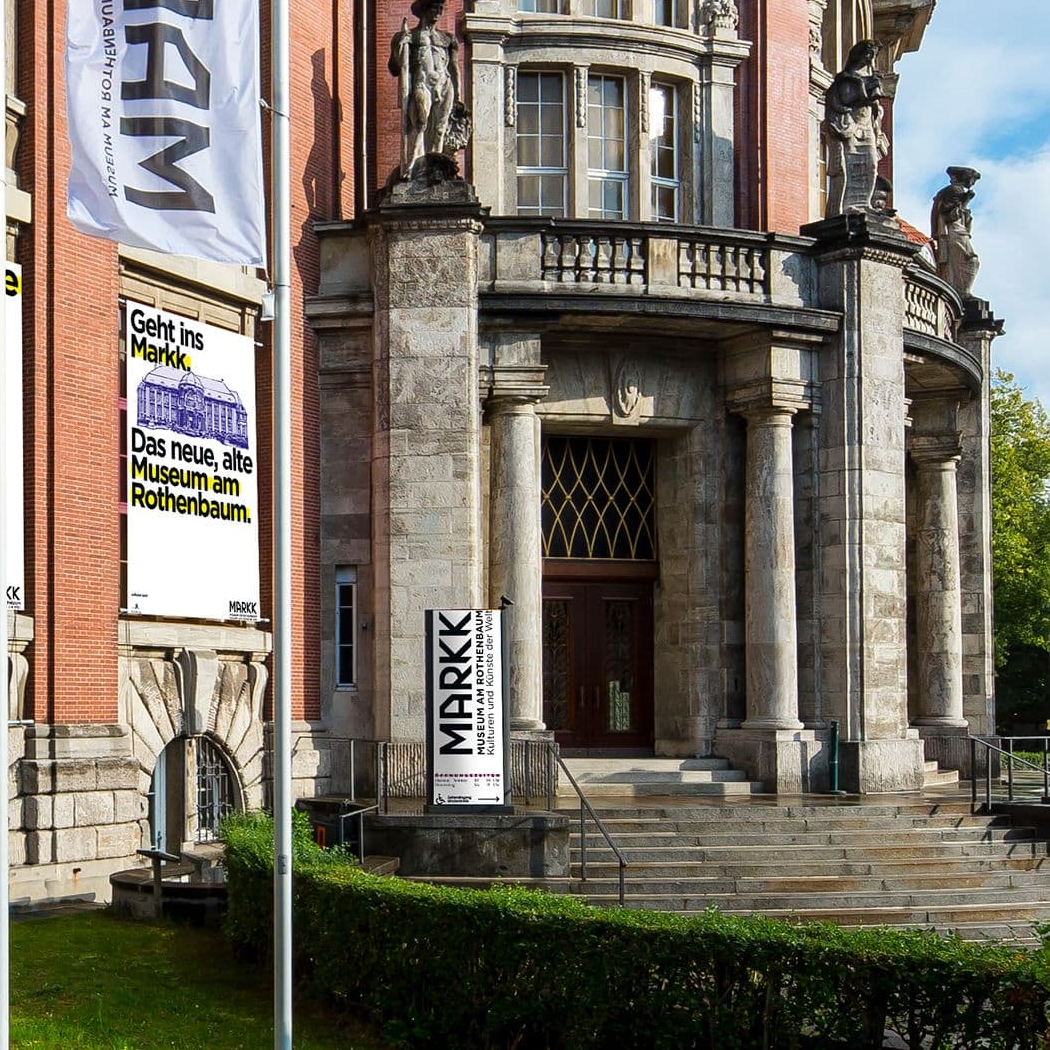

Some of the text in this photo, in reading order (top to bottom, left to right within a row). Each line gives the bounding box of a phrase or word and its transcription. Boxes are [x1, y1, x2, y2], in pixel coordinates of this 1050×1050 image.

[130, 309, 204, 351] Geht ins
[131, 334, 191, 372] Markk.
[131, 427, 254, 475] Das neue, alte
[131, 455, 240, 497] Museum am
[131, 483, 252, 524] Rothenbaum.
[229, 600, 258, 614] MARKK
[439, 611, 473, 755] MARKK
[475, 610, 486, 755] MUSEUM AM ROTHENBAUM
[485, 610, 495, 756] Kulturen und Künste der Welt
